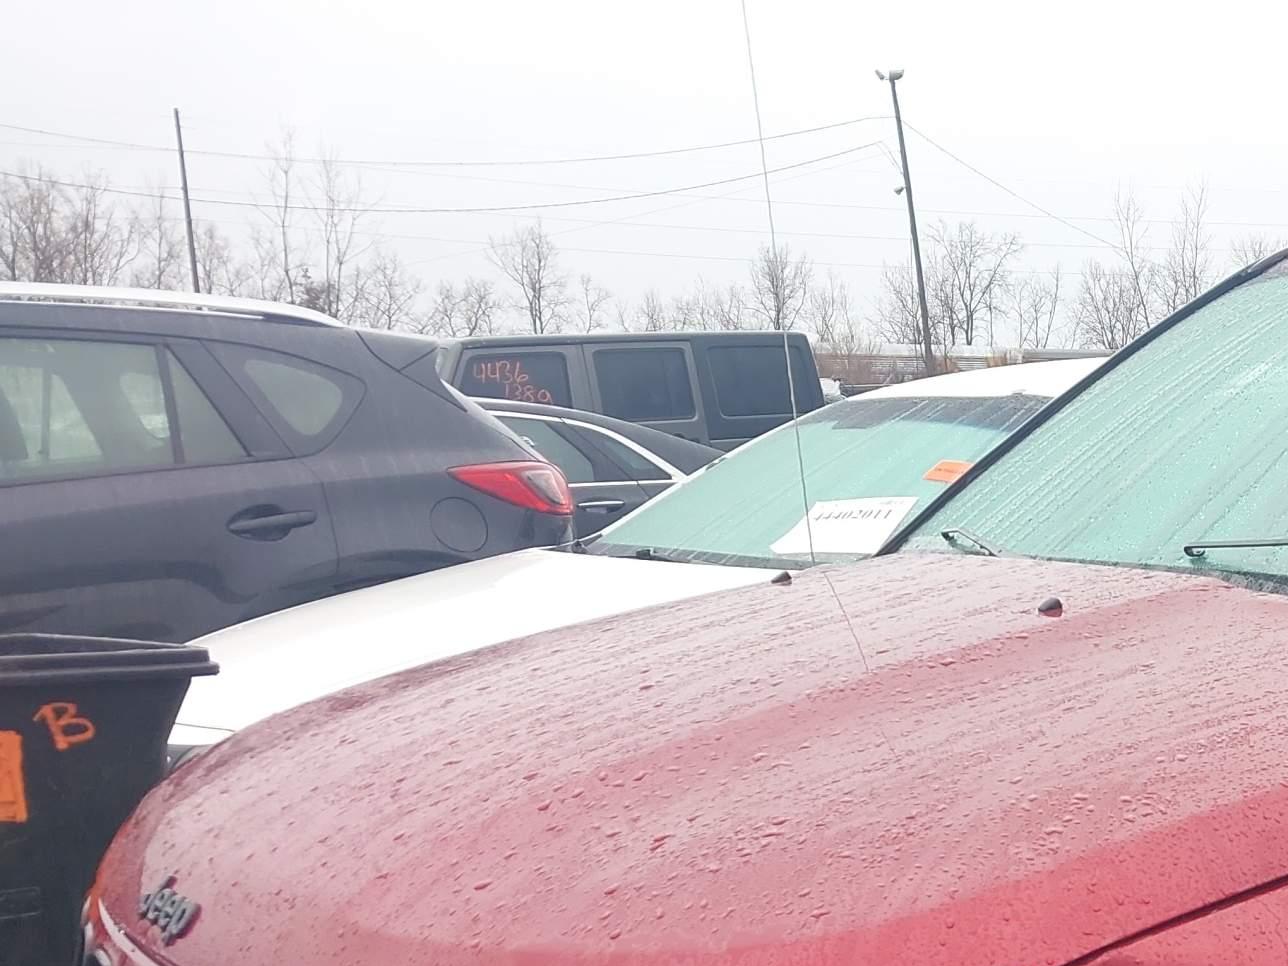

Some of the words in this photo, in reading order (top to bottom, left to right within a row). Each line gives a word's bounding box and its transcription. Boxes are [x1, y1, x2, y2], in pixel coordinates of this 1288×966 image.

[473, 361, 529, 384] 4436
[33, 702, 96, 750] B
[138, 877, 199, 947] Jeep
